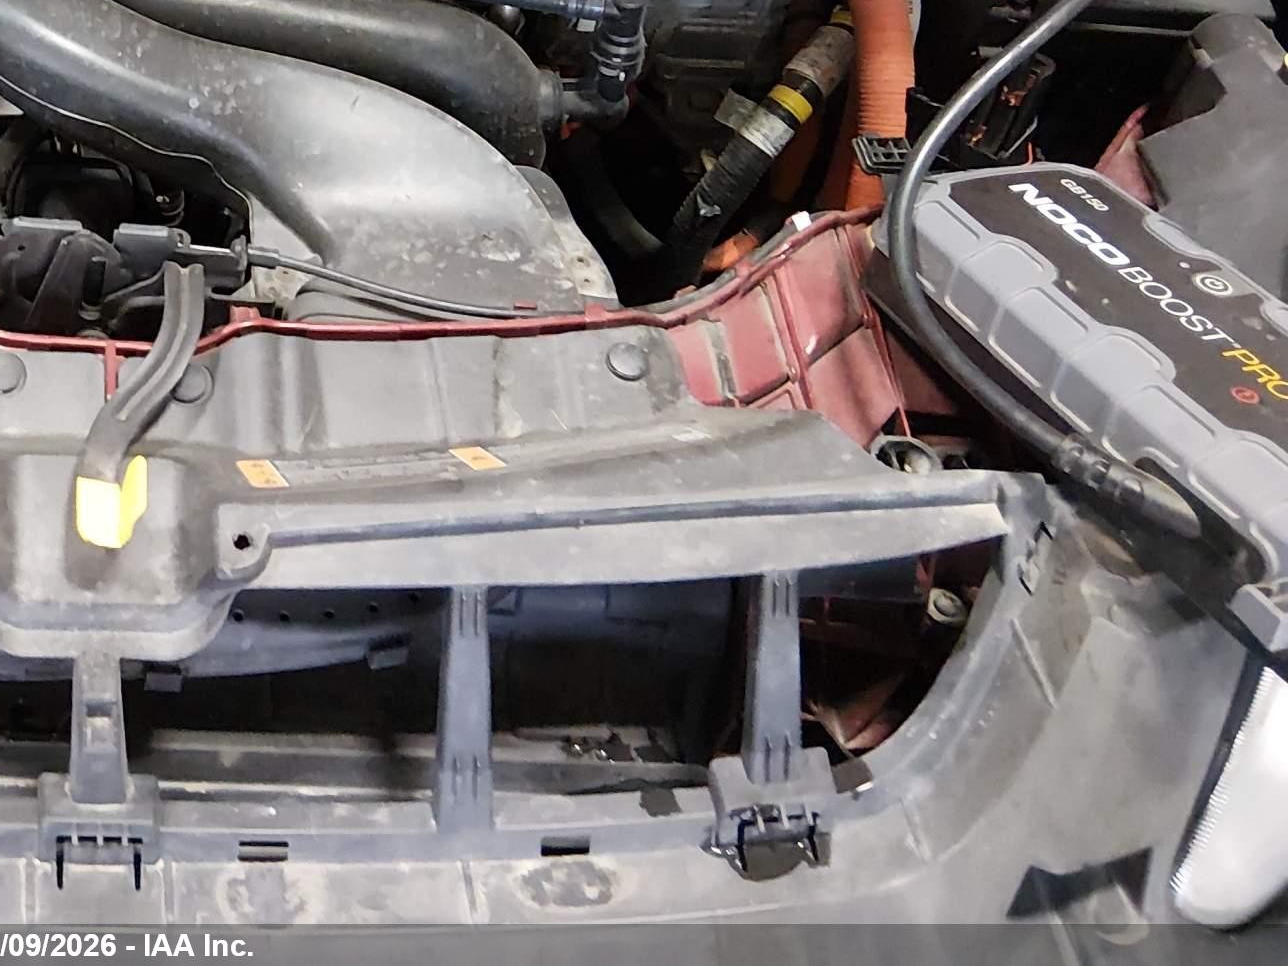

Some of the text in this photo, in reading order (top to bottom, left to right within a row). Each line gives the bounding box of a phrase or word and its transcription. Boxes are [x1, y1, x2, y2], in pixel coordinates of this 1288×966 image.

[1059, 178, 1109, 212] GB150
[1008, 182, 1131, 266] NOCO
[1118, 266, 1234, 346] BOOST
